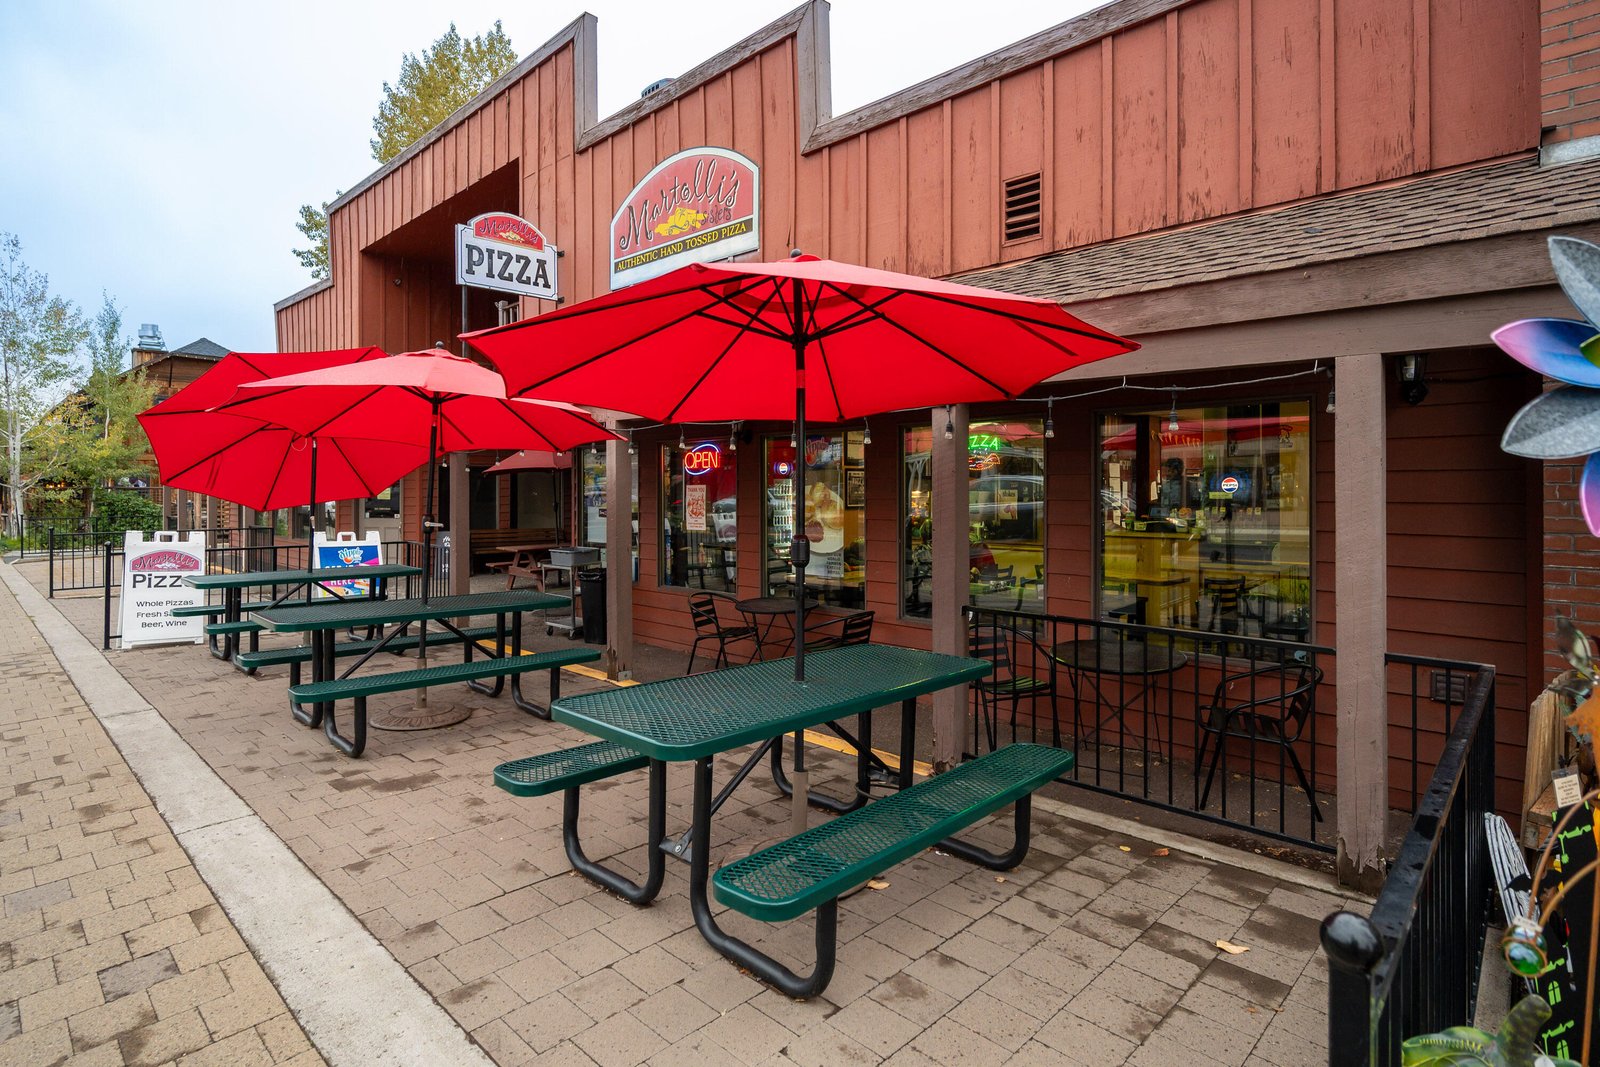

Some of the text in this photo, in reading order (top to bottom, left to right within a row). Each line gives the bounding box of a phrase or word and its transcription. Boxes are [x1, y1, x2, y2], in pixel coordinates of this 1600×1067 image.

[620, 159, 740, 251] Martolli's
[465, 243, 551, 289] PIZZA
[617, 222, 746, 270] AUTHENTIC HAND TOSSED PIZZA
[685, 451, 718, 469] OPEN
[132, 573, 182, 588] Pizz
